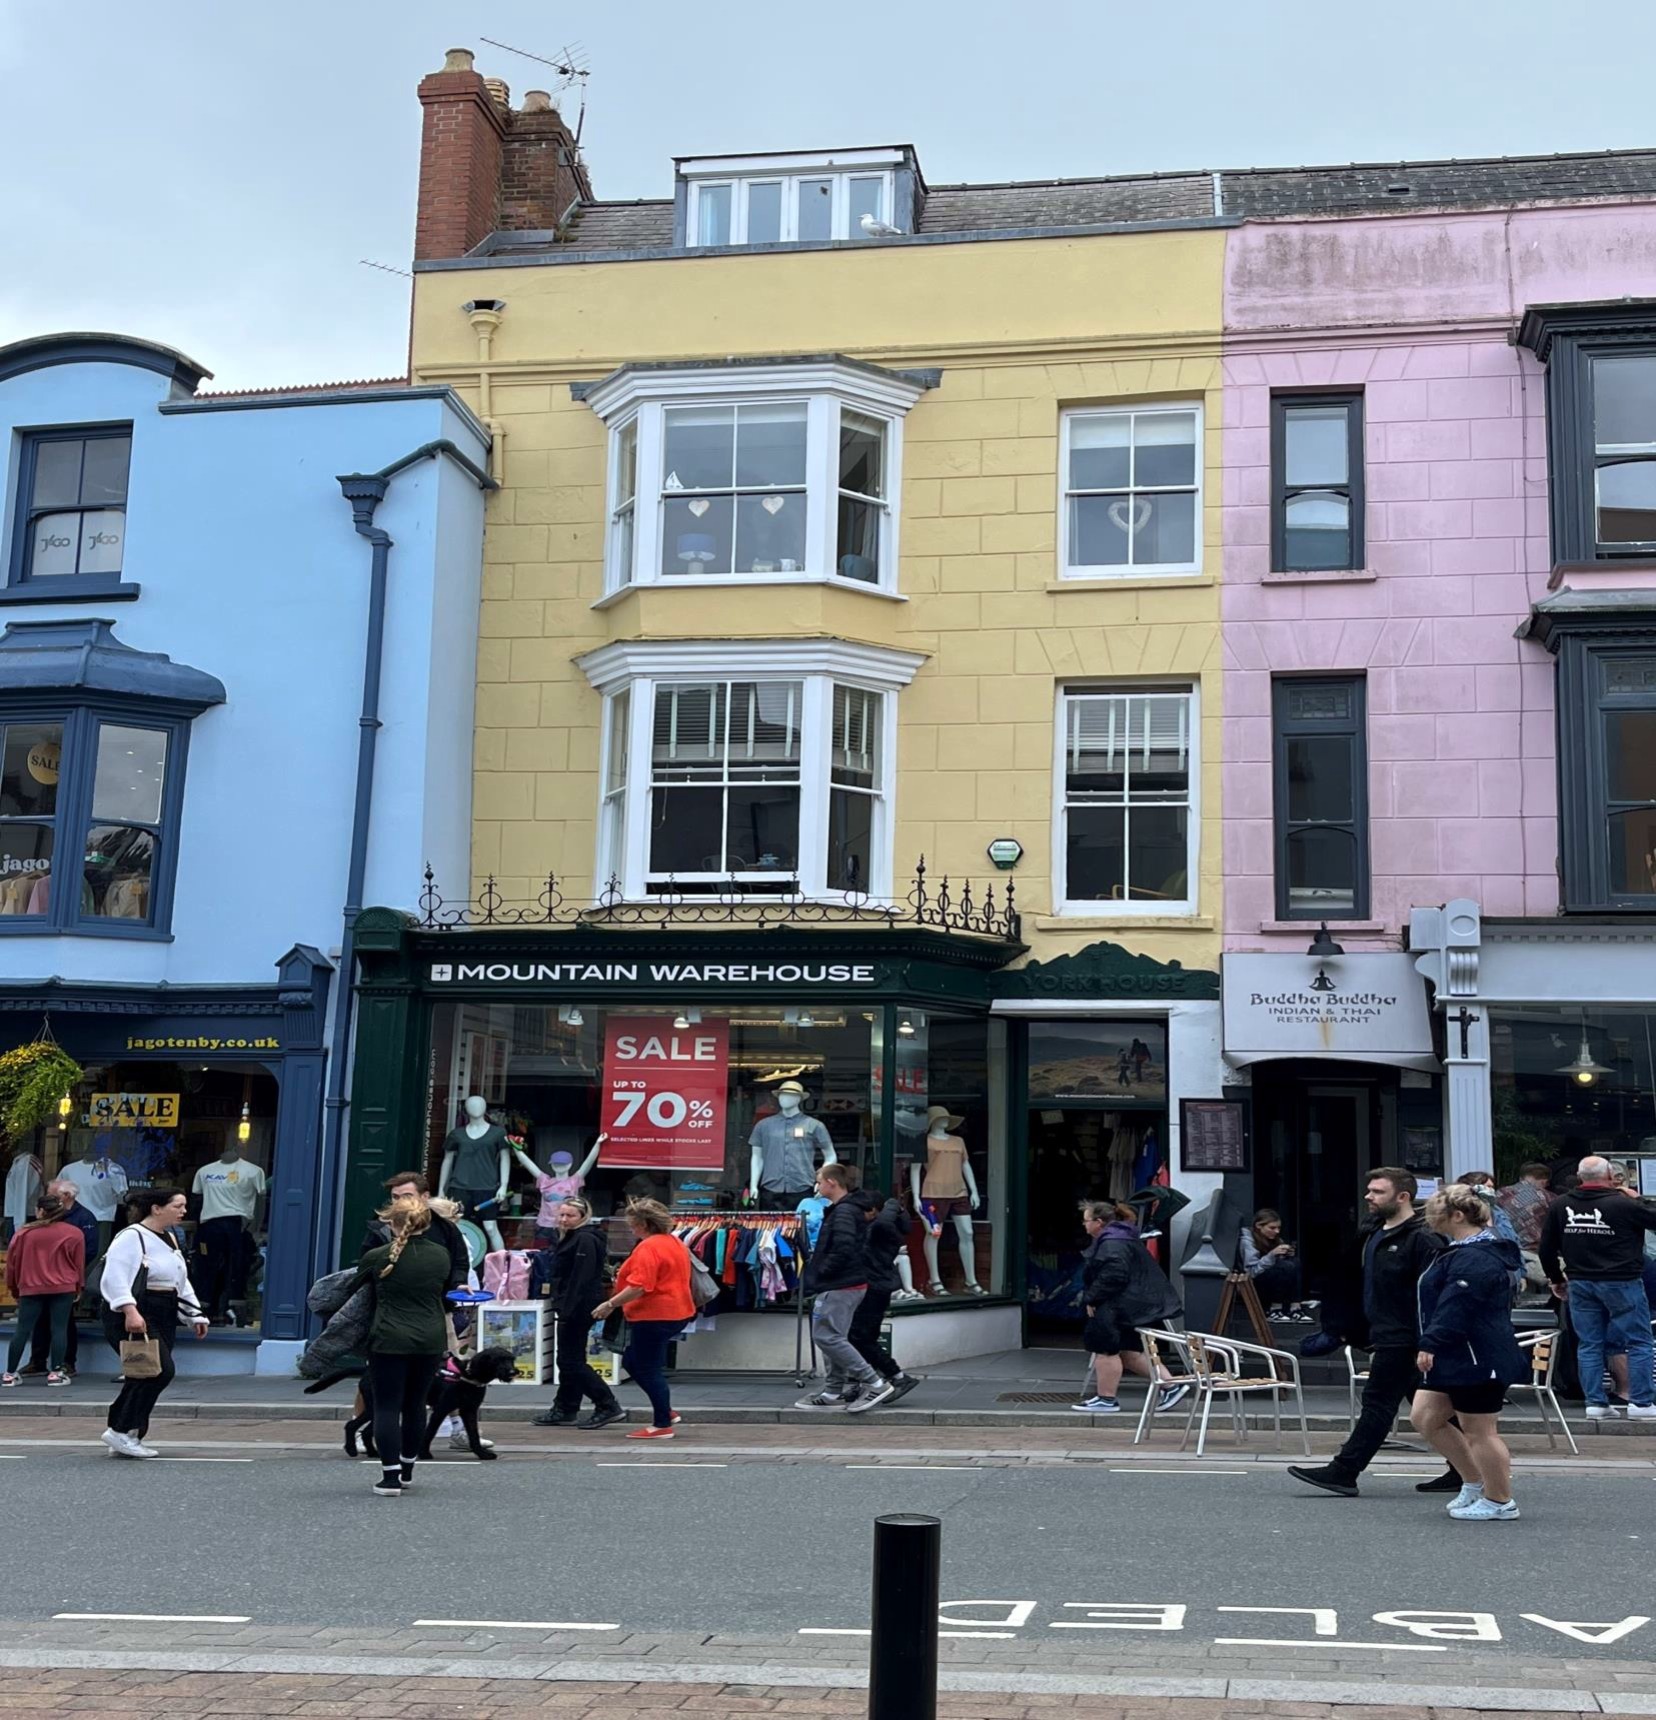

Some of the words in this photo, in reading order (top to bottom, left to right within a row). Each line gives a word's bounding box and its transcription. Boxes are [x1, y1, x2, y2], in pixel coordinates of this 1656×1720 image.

[457, 963, 637, 982] MOUNTAIN
[650, 963, 875, 982] WAREHOUSE
[1021, 973, 1093, 993] YORK
[1099, 973, 1186, 994] HOUSE
[1250, 993, 1321, 1006] Buddha
[1326, 993, 1397, 1006] Buddha
[1268, 1007, 1321, 1015] INDIAN
[1276, 1016, 1370, 1024] RESTAURANT
[126, 1036, 280, 1050] jagotenby.co.uk
[615, 1036, 717, 1061] SALE
[613, 1080, 629, 1089] UP
[630, 1080, 647, 1089] TO
[95, 1096, 174, 1118] SALE
[612, 1091, 714, 1129] 70%
[688, 1120, 714, 1129] OFF
